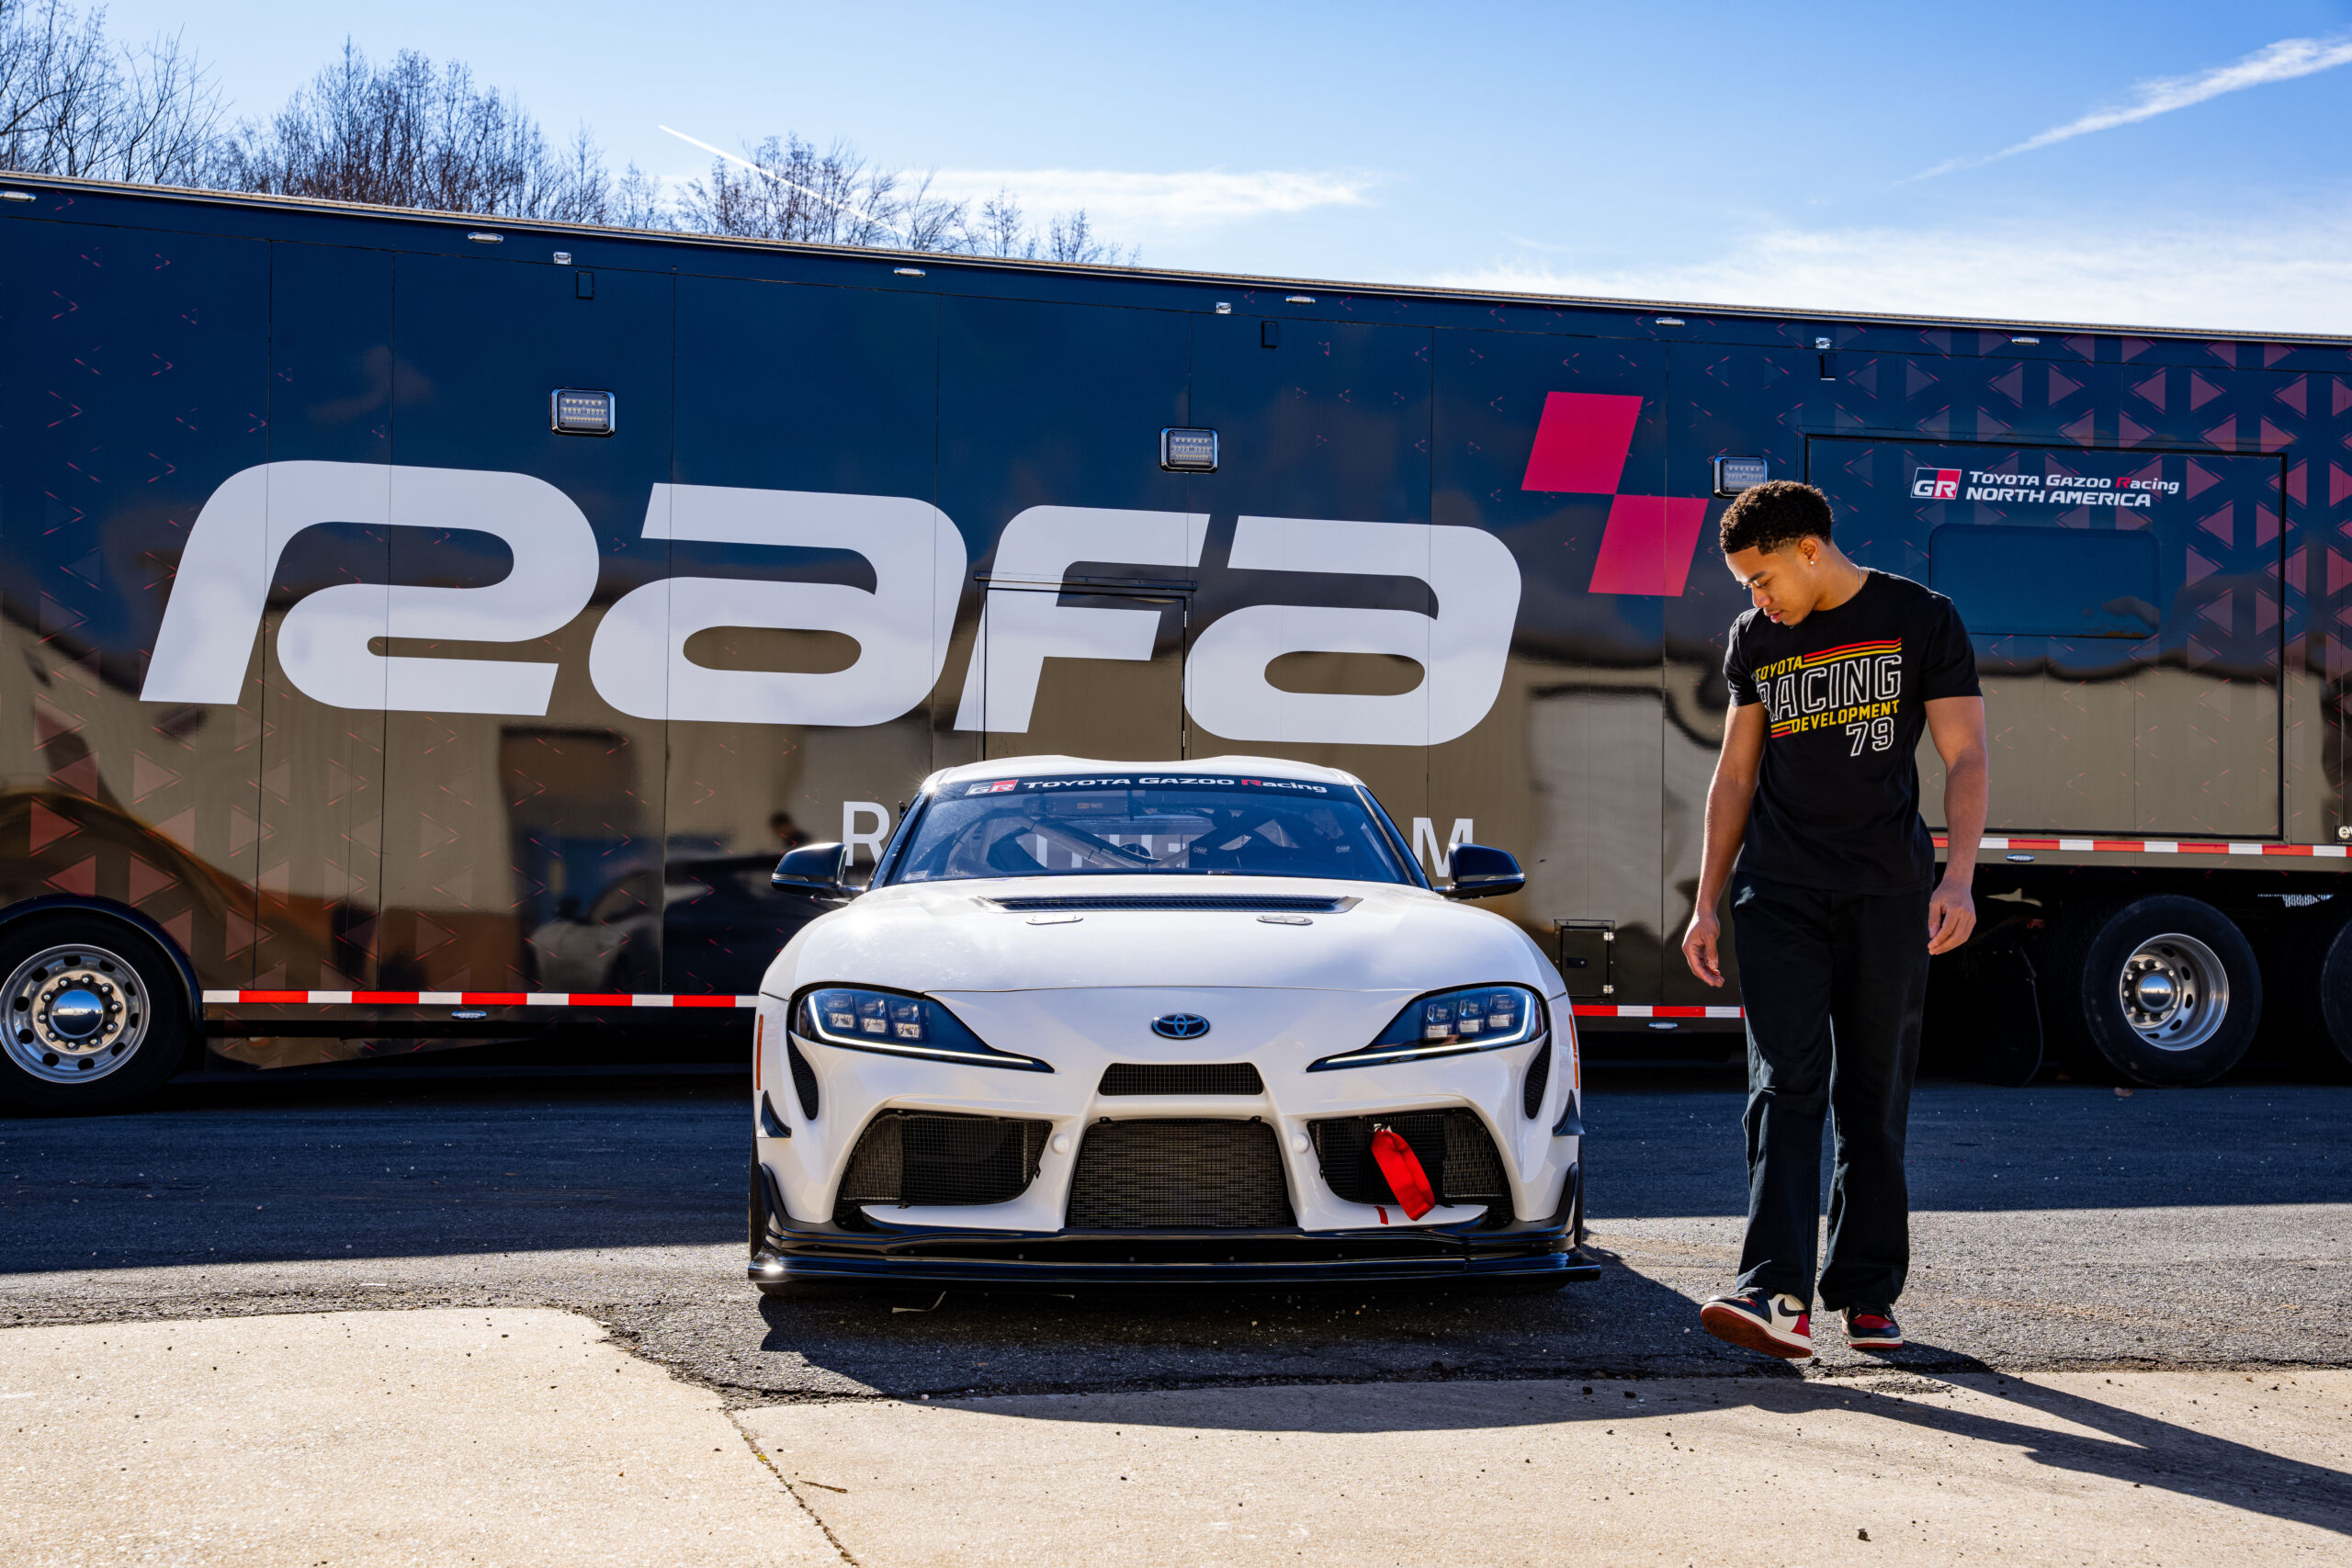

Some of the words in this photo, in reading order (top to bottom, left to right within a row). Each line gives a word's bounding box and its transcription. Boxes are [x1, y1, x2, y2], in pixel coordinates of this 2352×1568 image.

[1969, 470, 2040, 486] TOYOTA
[2046, 474, 2111, 489] GAZOO
[2115, 477, 2179, 494] Racing
[1966, 487, 2045, 503] NORTH
[2049, 491, 2152, 507] AMERICA
[1756, 656, 1804, 682] TOYOTA
[1757, 654, 1902, 722] RACING
[1792, 699, 1900, 733] DEVELOPMENT
[1846, 716, 1894, 757] 79
[1023, 778, 1131, 789] TOYOTA
[1138, 777, 1236, 785] GAZOO
[1241, 778, 1328, 794] Racing
